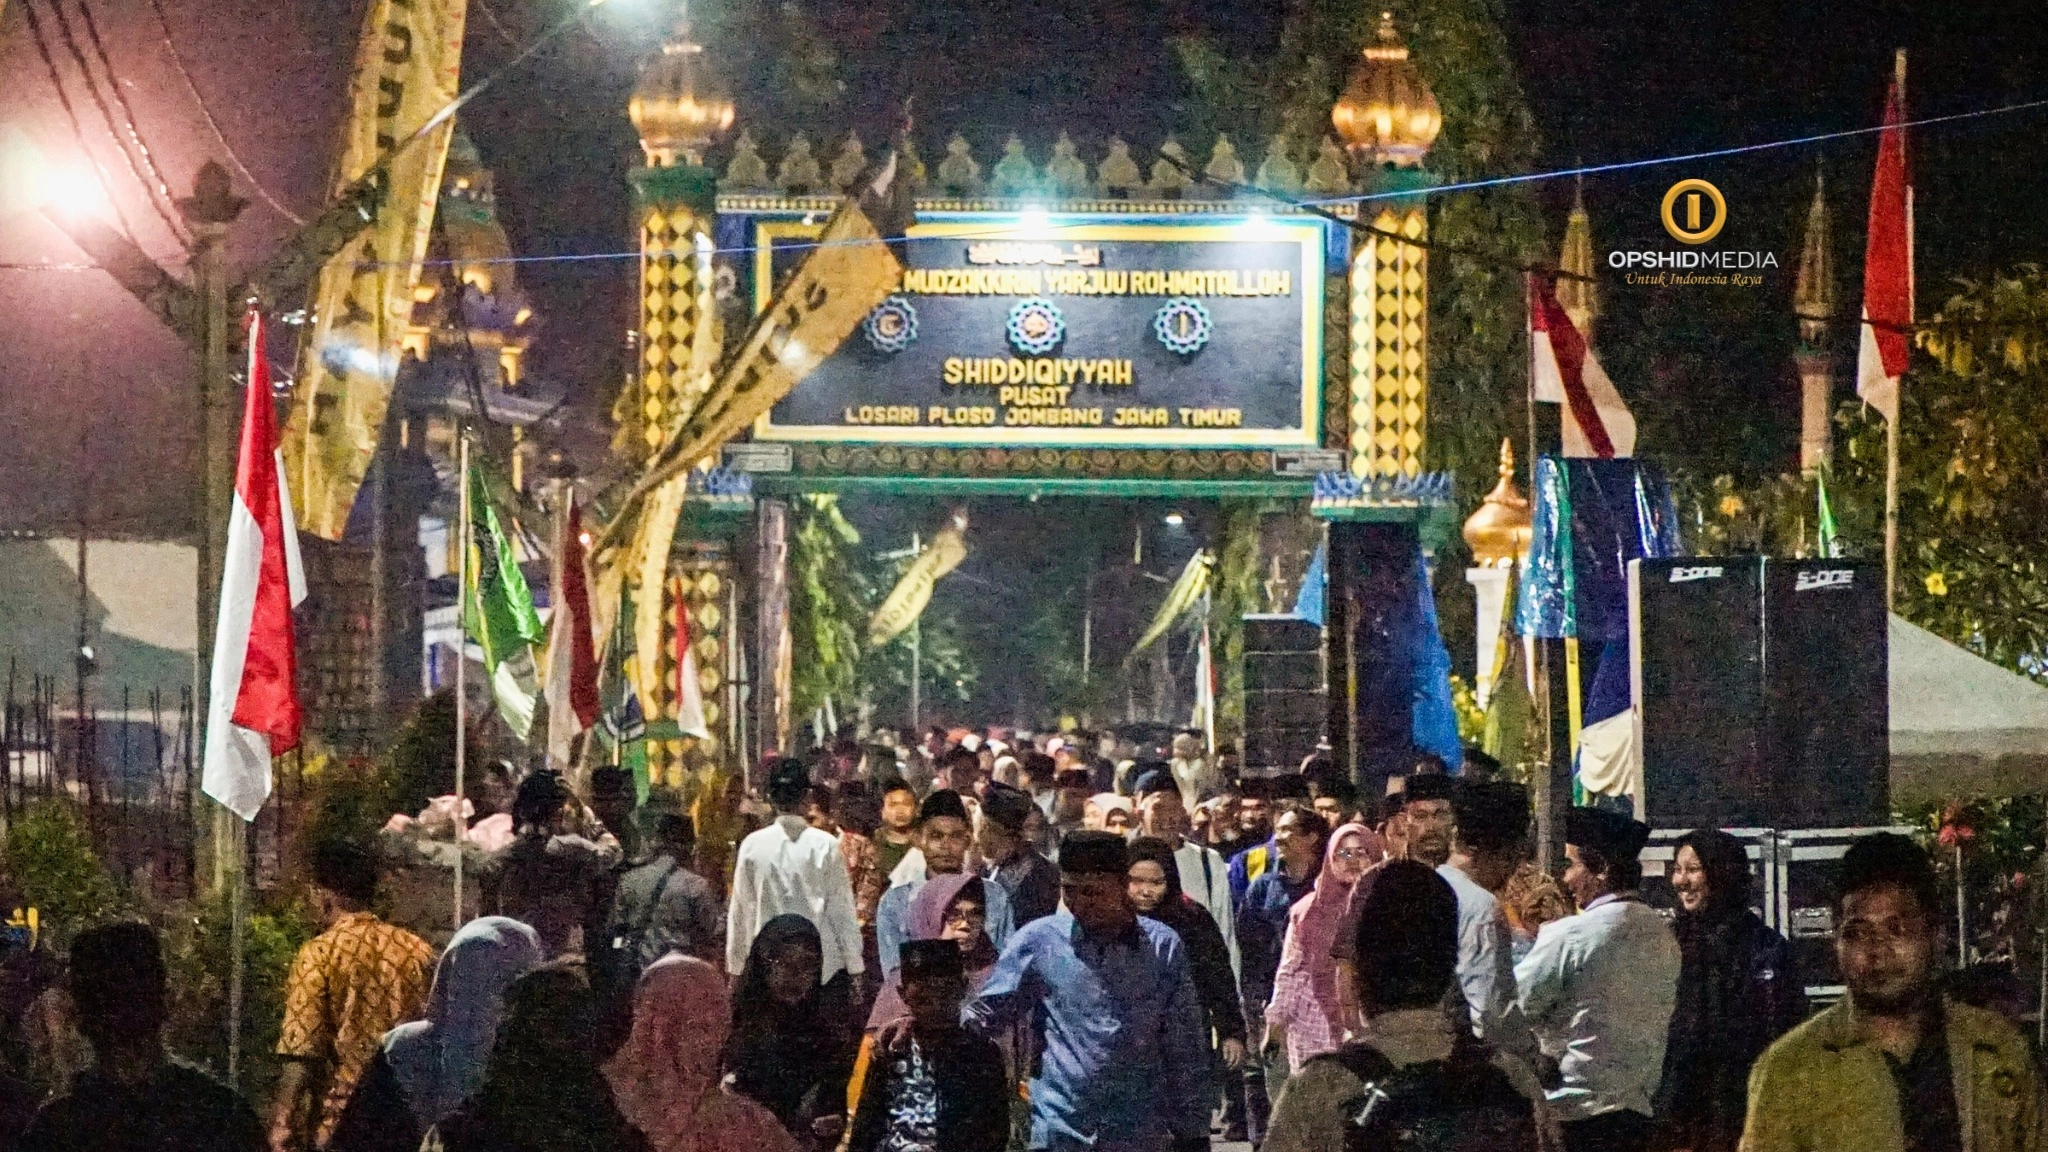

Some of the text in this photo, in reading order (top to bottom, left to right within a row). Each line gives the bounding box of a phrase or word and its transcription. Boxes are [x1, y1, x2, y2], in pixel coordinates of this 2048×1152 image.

[1043, 269, 1128, 295] YARJUU
[943, 357, 1133, 386] SHIDDIQIYYAH
[1000, 385, 1071, 406] PUSAT
[845, 405, 1243, 427] LOSARI PLOSO JOMBANG JAWA TIMUR
